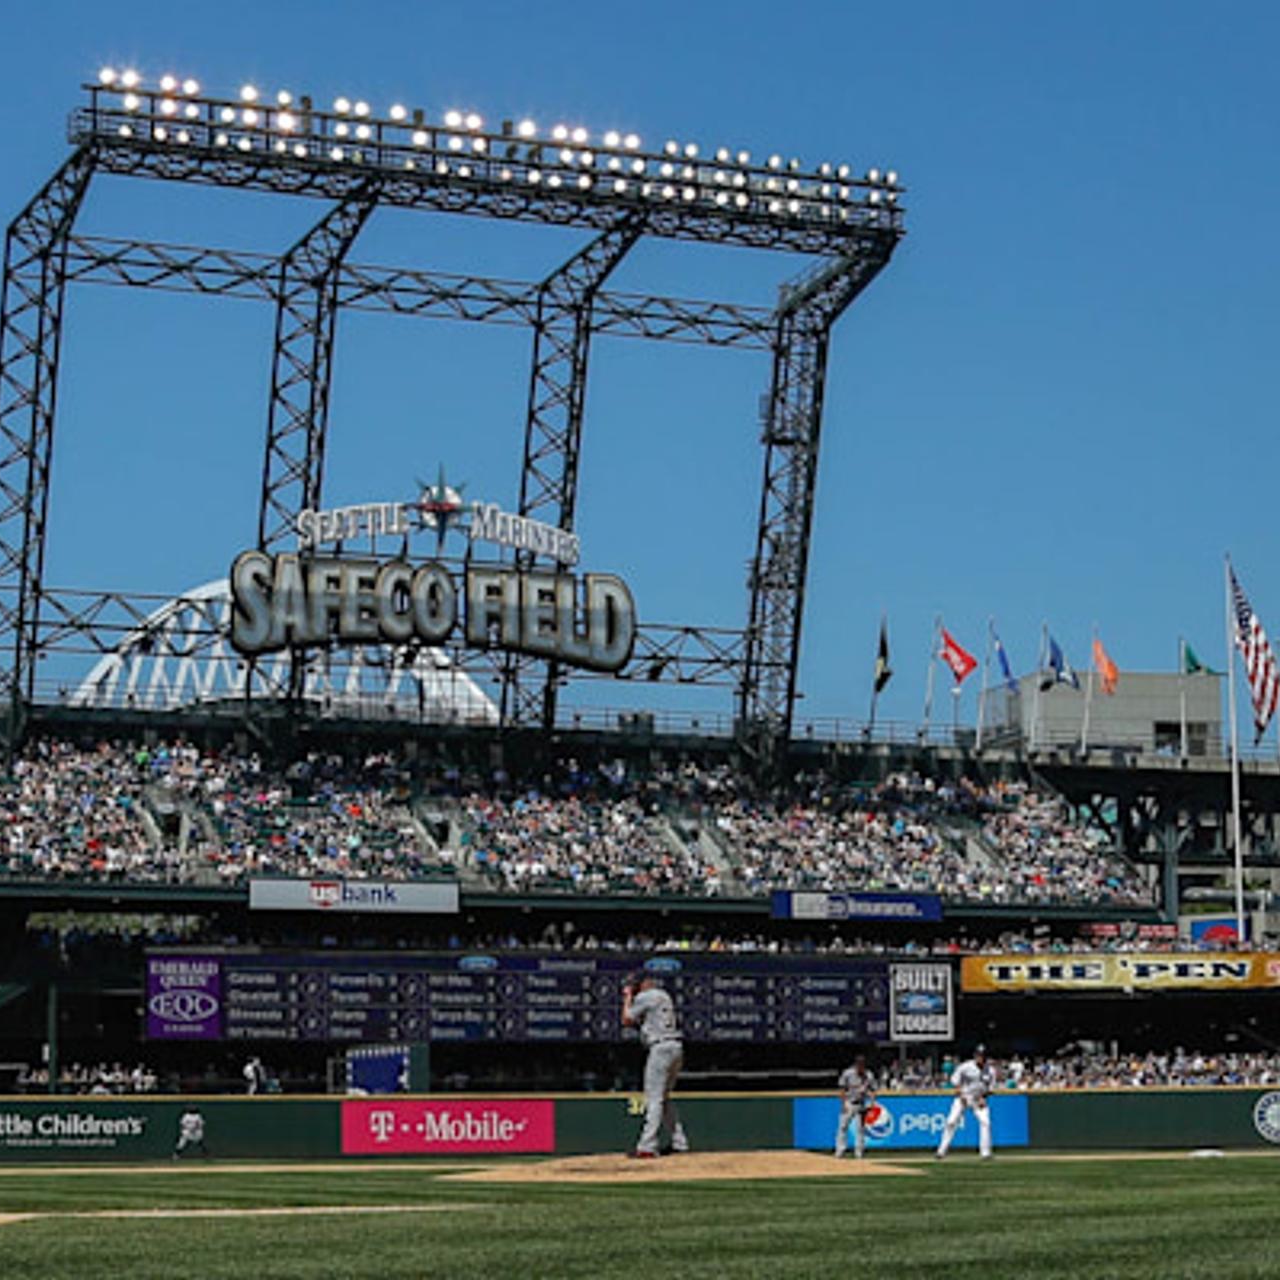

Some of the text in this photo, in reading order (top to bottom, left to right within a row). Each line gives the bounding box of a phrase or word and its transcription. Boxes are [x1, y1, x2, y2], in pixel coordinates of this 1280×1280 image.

[297, 500, 580, 566] SEATTLE MARINERS
[231, 550, 636, 674] SAFECO FIELD
[150, 961, 218, 975] EMERALD
[896, 969, 946, 990] BUILT
[987, 962, 1106, 982] THE
[150, 991, 218, 1021] EQC
[37, 1113, 144, 1136] Children's
